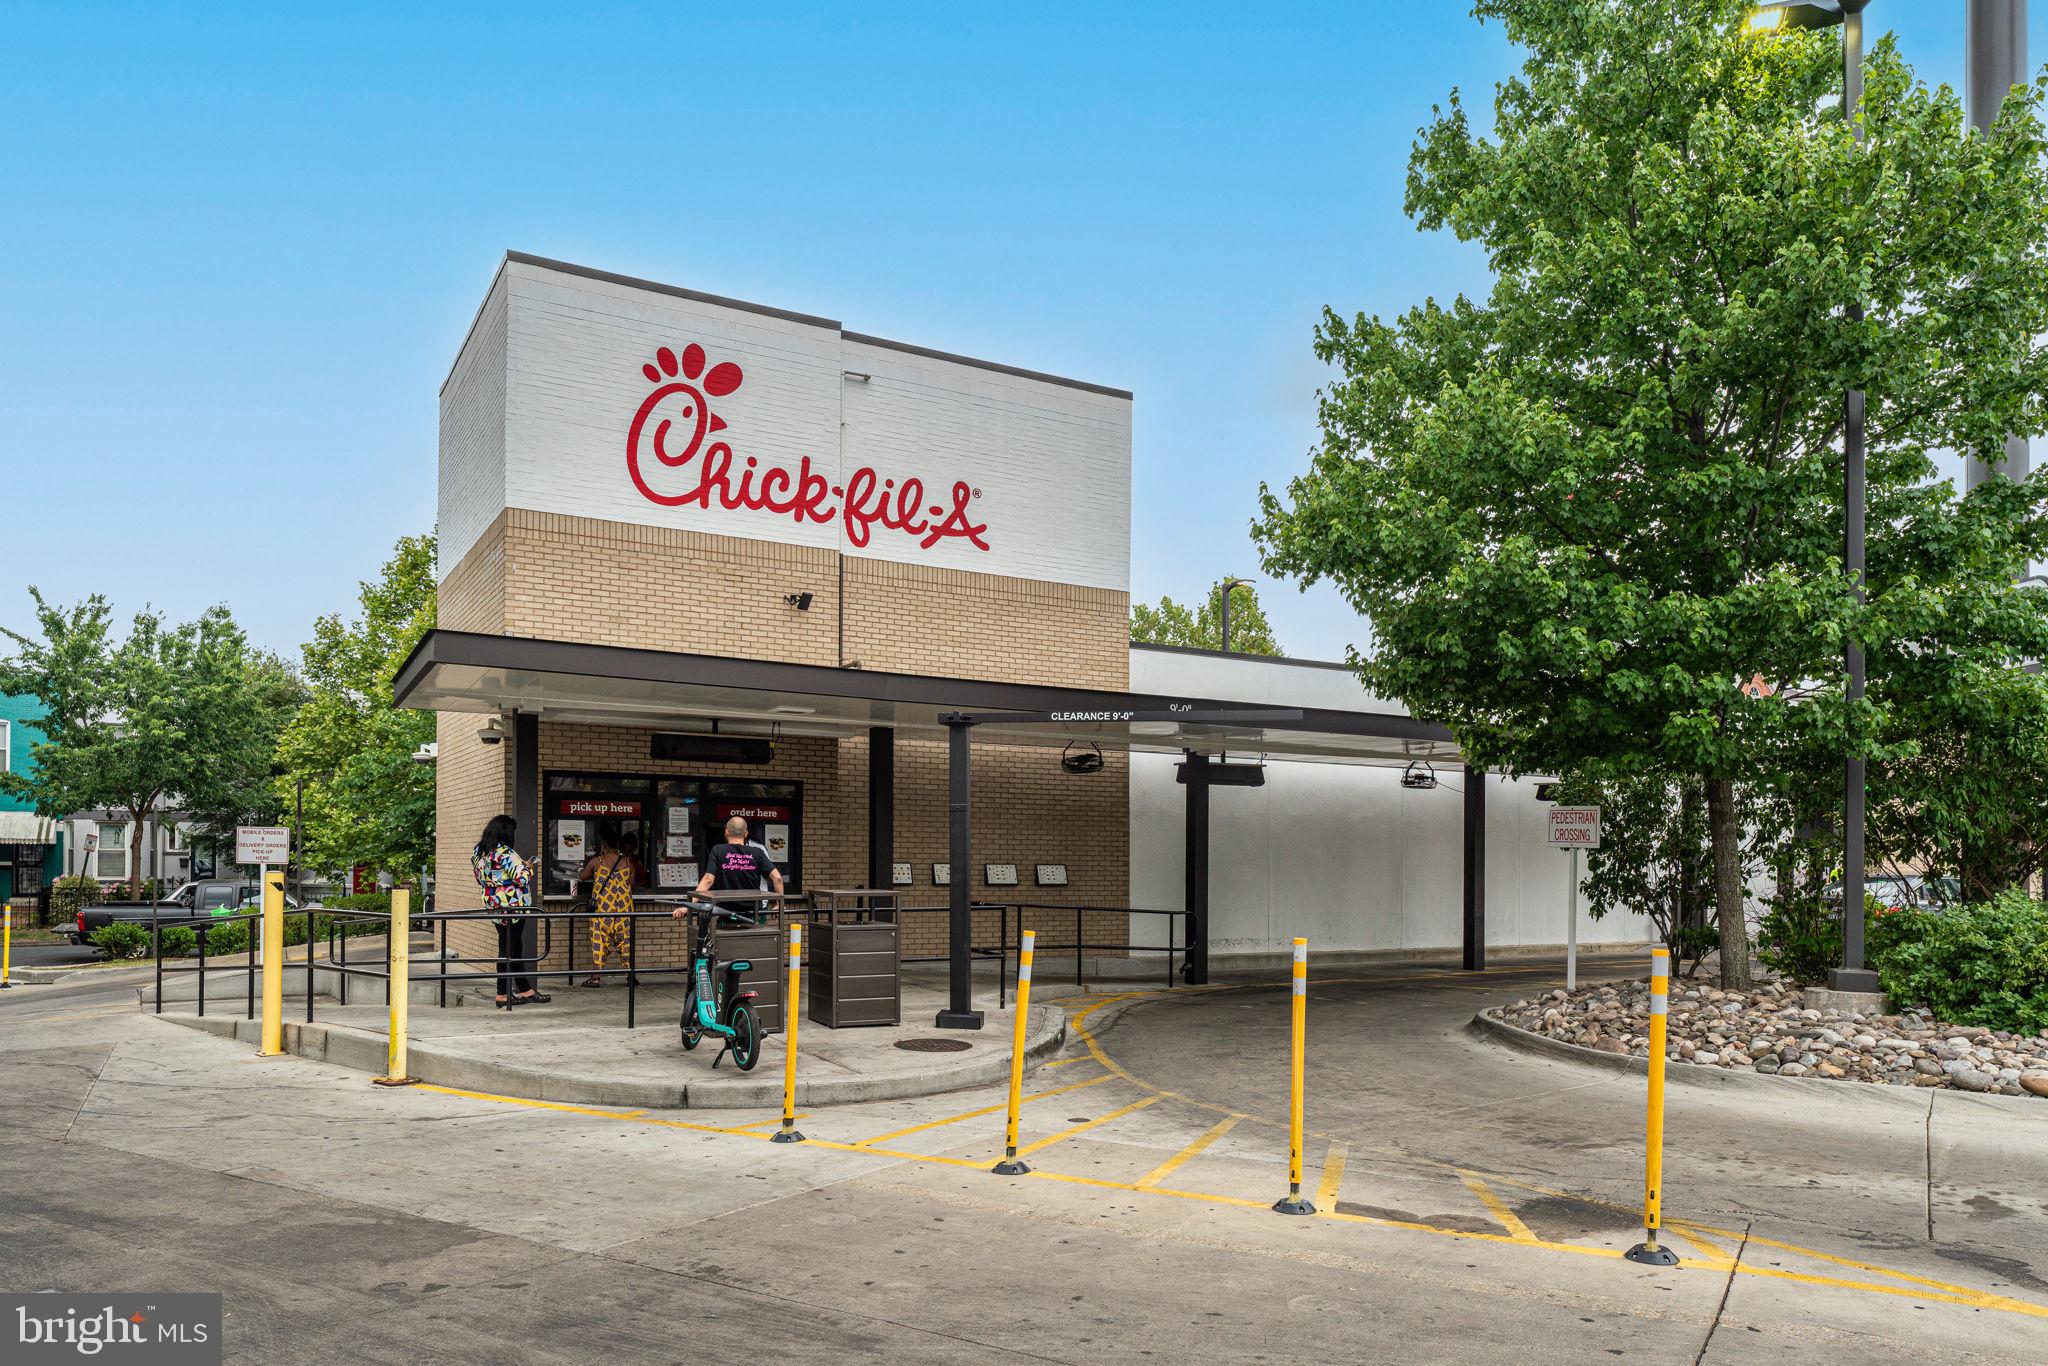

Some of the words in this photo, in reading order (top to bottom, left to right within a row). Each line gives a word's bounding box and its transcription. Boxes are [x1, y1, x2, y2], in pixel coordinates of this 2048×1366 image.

[1051, 712, 1110, 720] CLEARANCE
[1112, 712, 1134, 720] 9'-0"
[570, 802, 592, 814] pick
[594, 804, 608, 814] up
[610, 803, 633, 813] here
[730, 808, 755, 817] order
[756, 809, 778, 818] here
[1551, 811, 1596, 824] PEDESTRIAN
[1554, 828, 1591, 841] CROSSING
